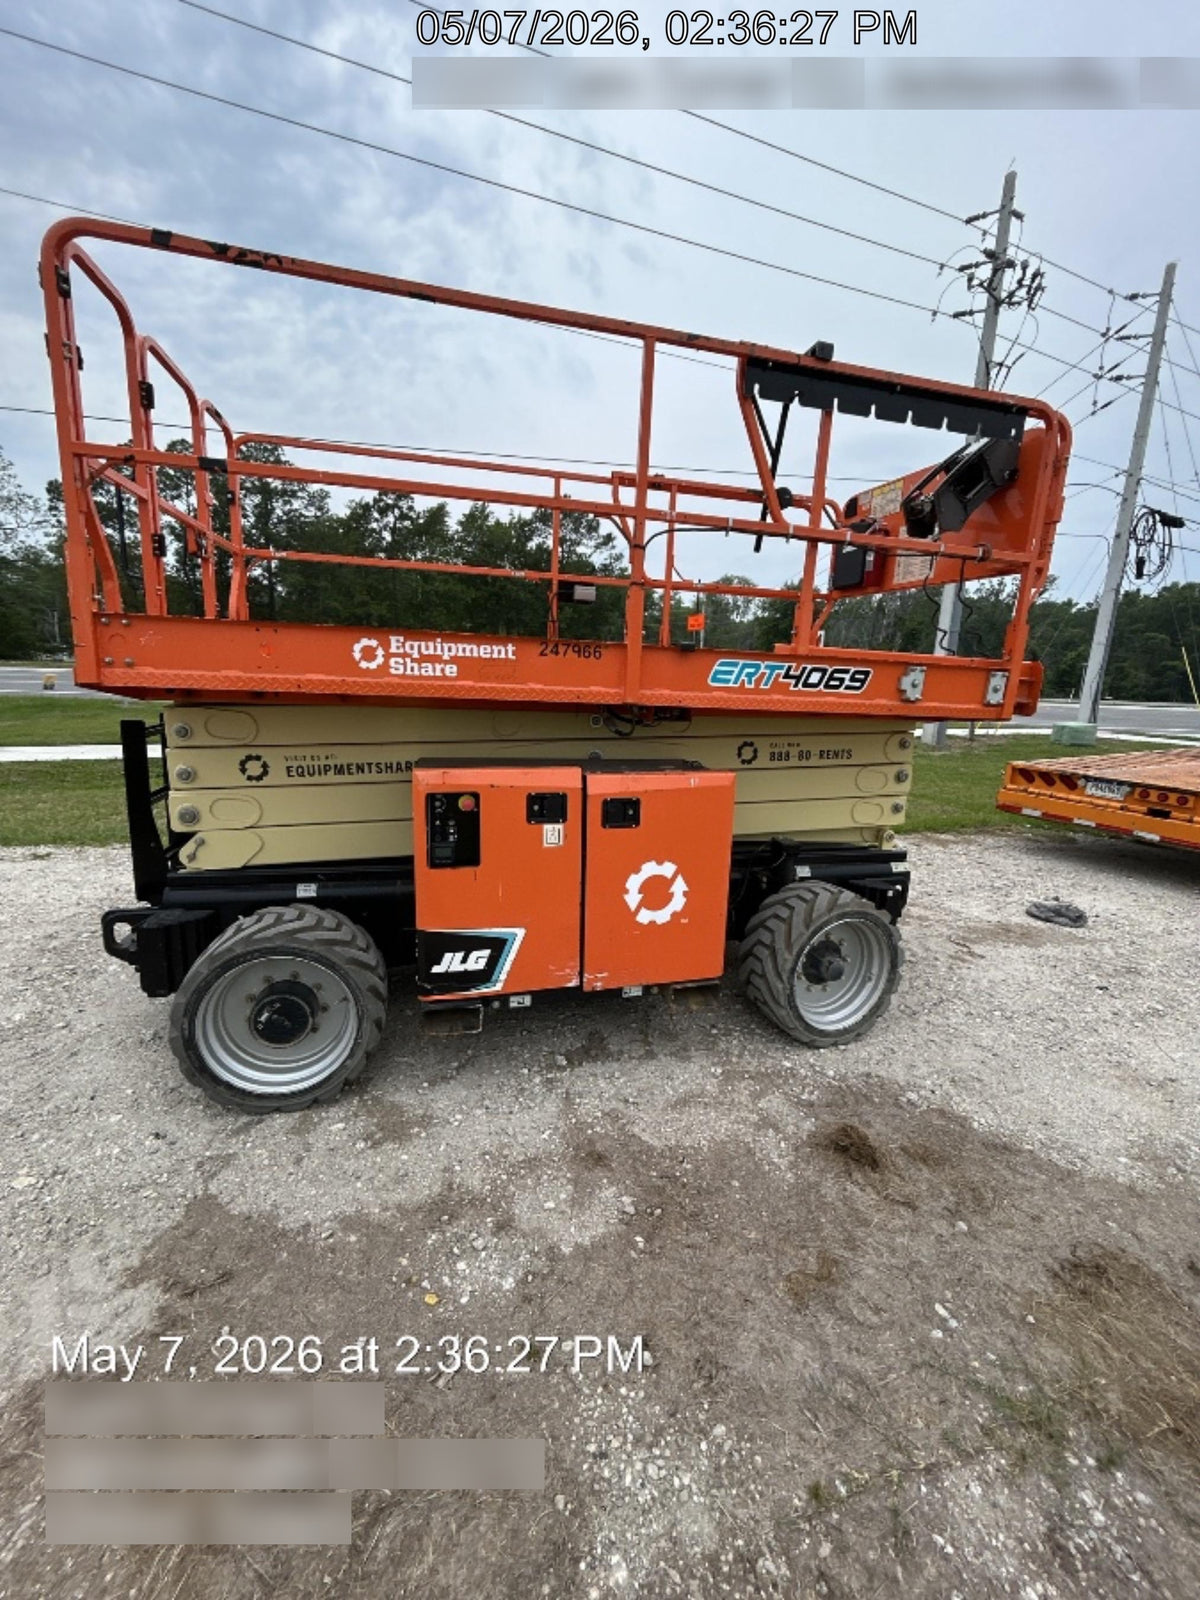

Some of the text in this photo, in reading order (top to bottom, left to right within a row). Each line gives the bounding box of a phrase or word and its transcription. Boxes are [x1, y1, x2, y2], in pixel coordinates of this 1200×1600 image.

[389, 636, 516, 660] Equipment
[539, 641, 602, 660] 247966
[389, 658, 458, 677] Share
[708, 659, 872, 694] ERT4069
[286, 761, 418, 778] EQUIPMENTSHAR
[431, 950, 492, 973] JLG
